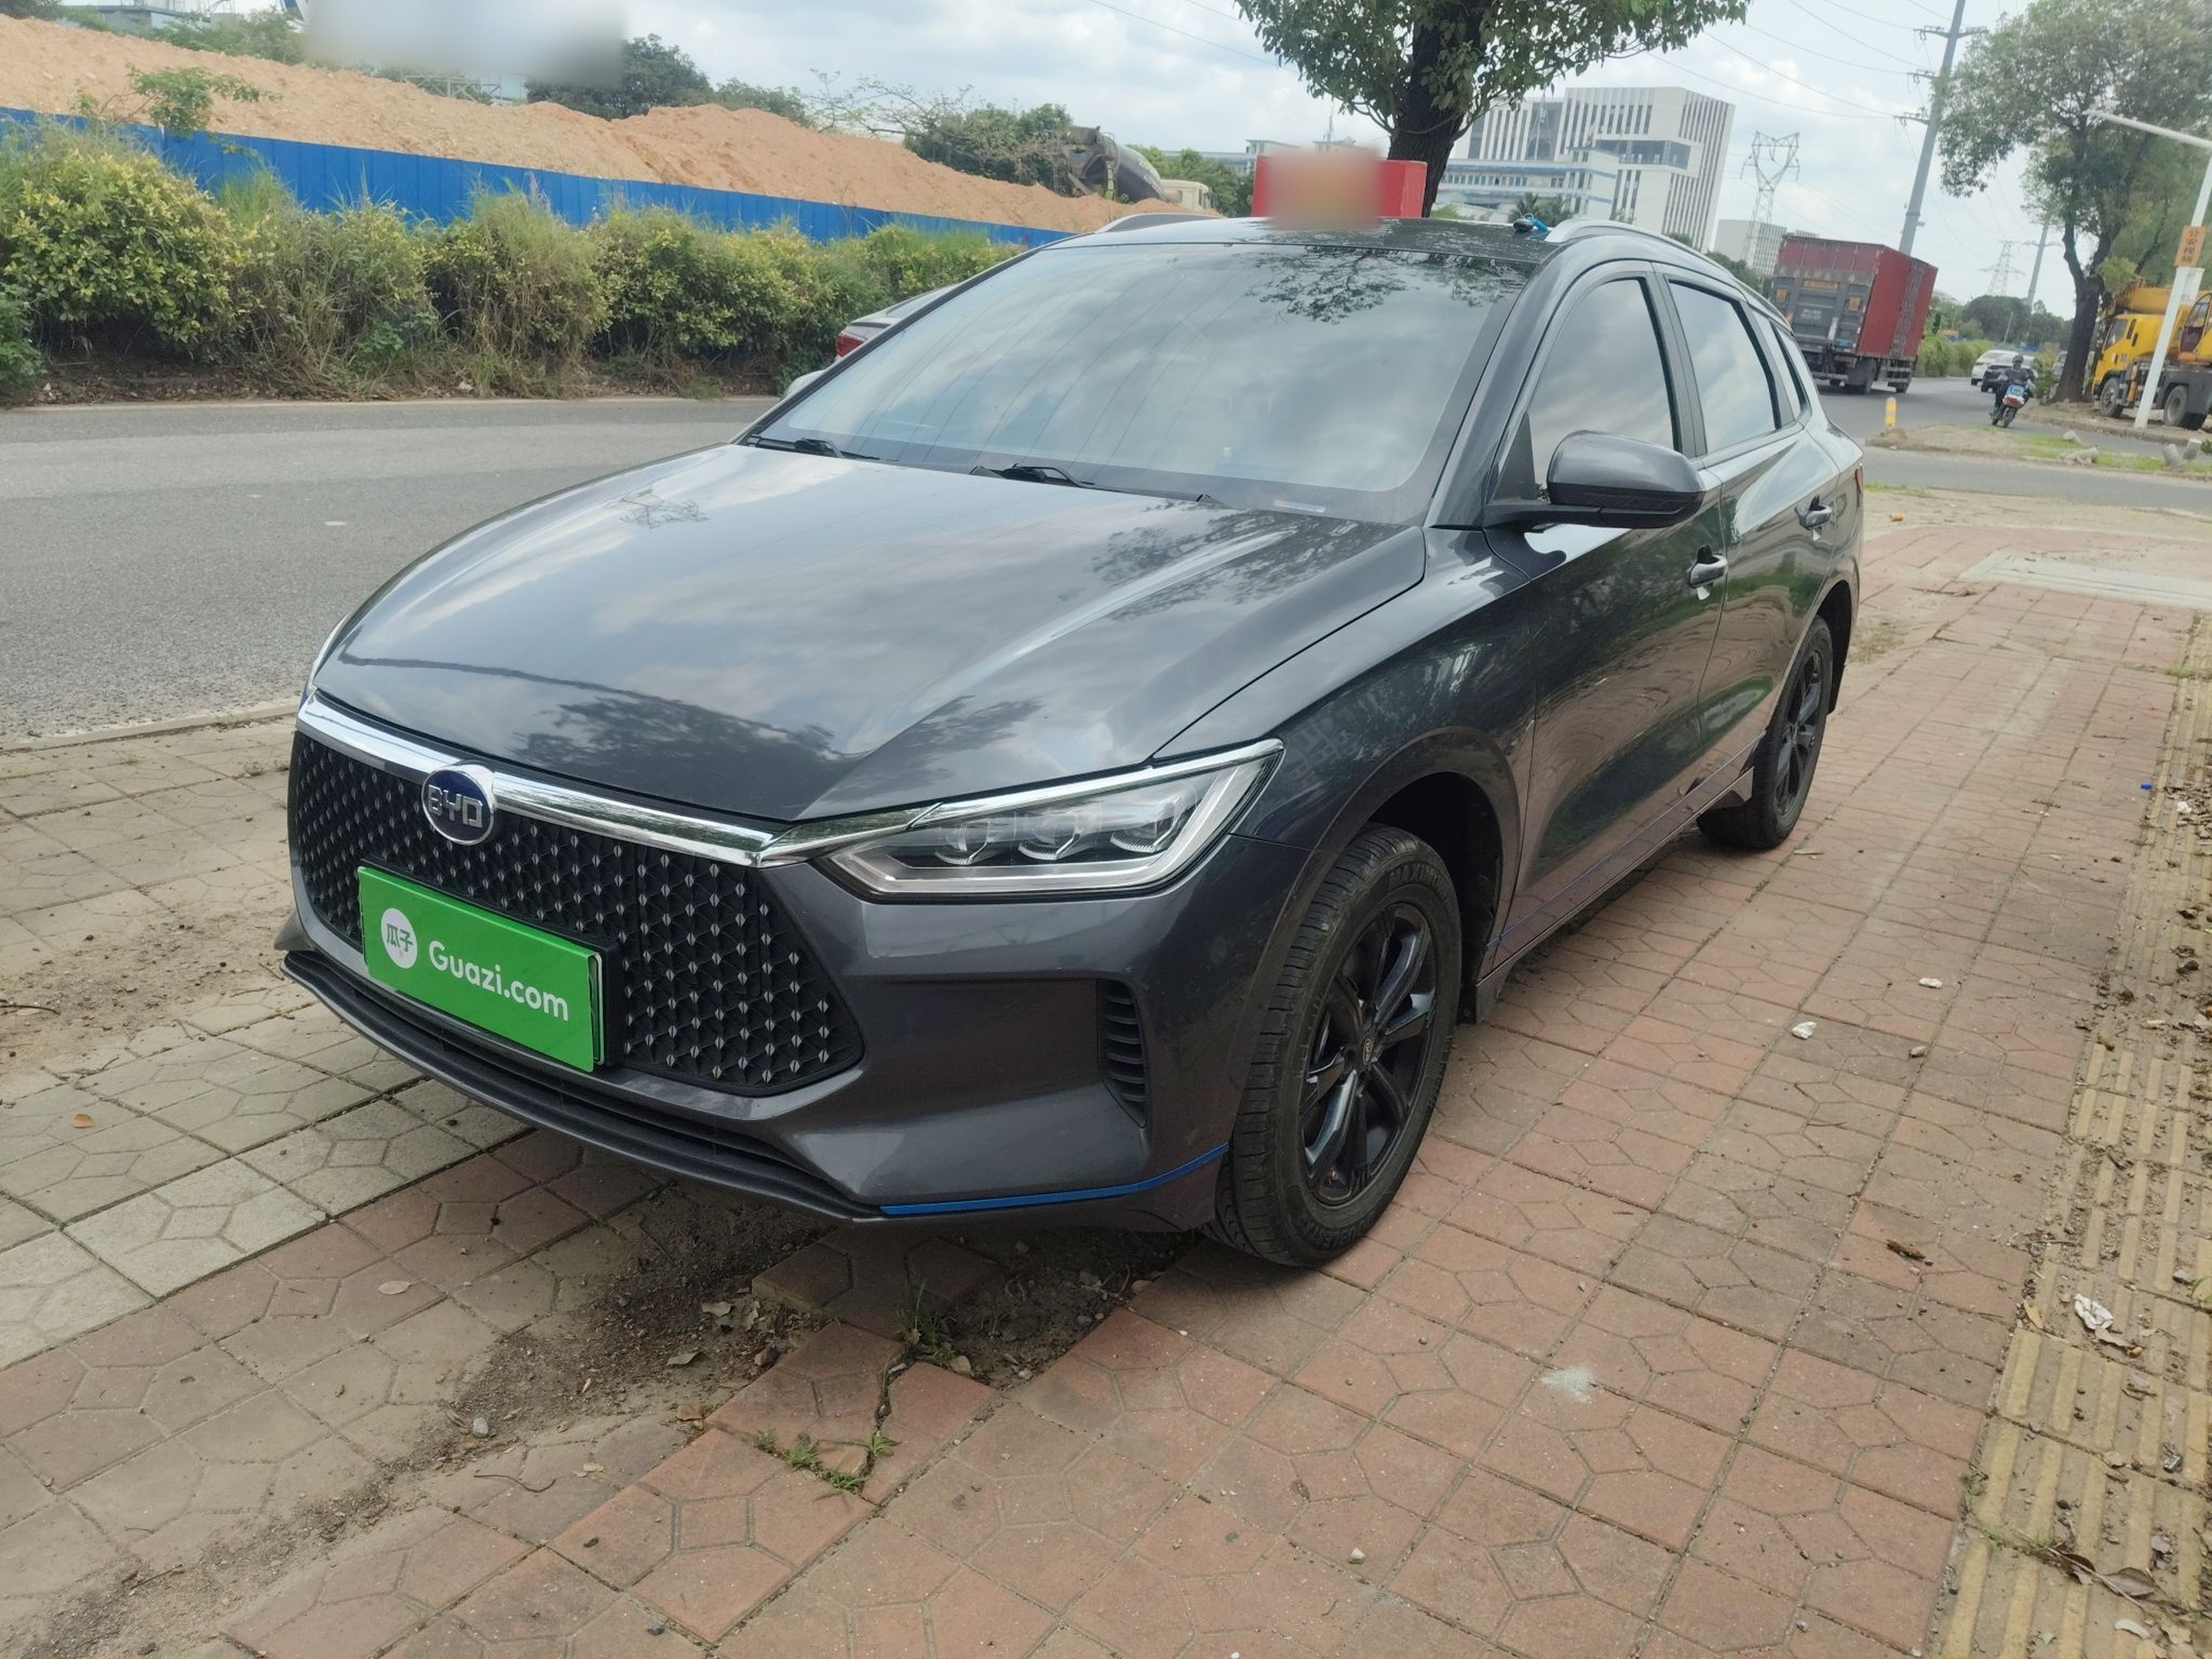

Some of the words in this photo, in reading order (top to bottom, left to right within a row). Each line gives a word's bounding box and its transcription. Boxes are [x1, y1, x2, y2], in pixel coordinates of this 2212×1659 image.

[428, 785, 483, 828] BYD
[386, 924, 413, 952] 瓜子
[429, 941, 568, 1021] Guazi.com
